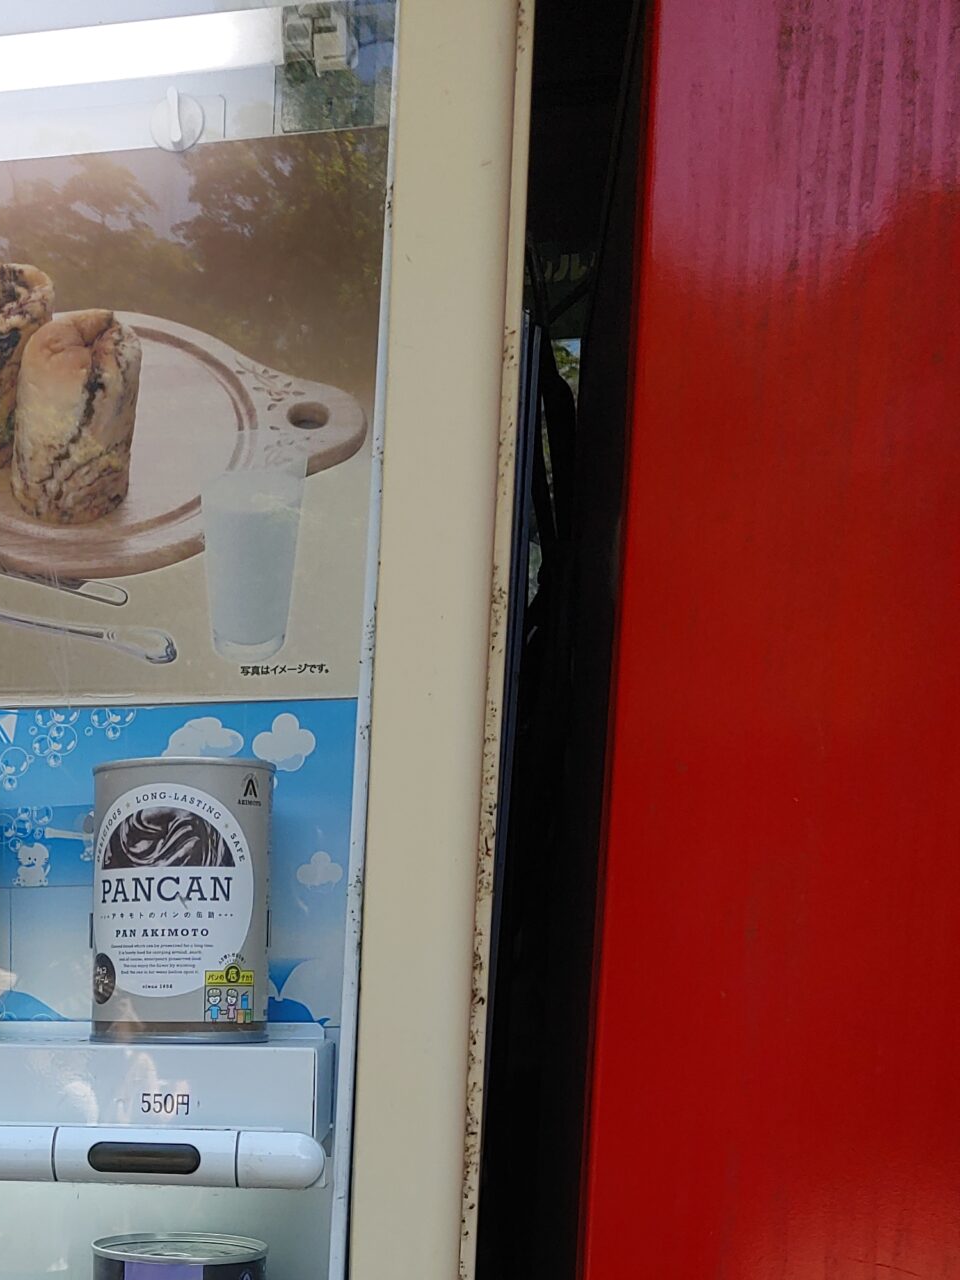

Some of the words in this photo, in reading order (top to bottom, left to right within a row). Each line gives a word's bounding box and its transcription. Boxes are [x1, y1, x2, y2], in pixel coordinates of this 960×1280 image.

[240, 663, 329, 676] 写真はイメージです。
[136, 792, 222, 820] LONG-LASTING
[101, 876, 233, 904] PANCAN
[115, 929, 137, 938] PAN
[141, 928, 210, 938] AKIMOTO
[141, 1093, 190, 1115] 550円
